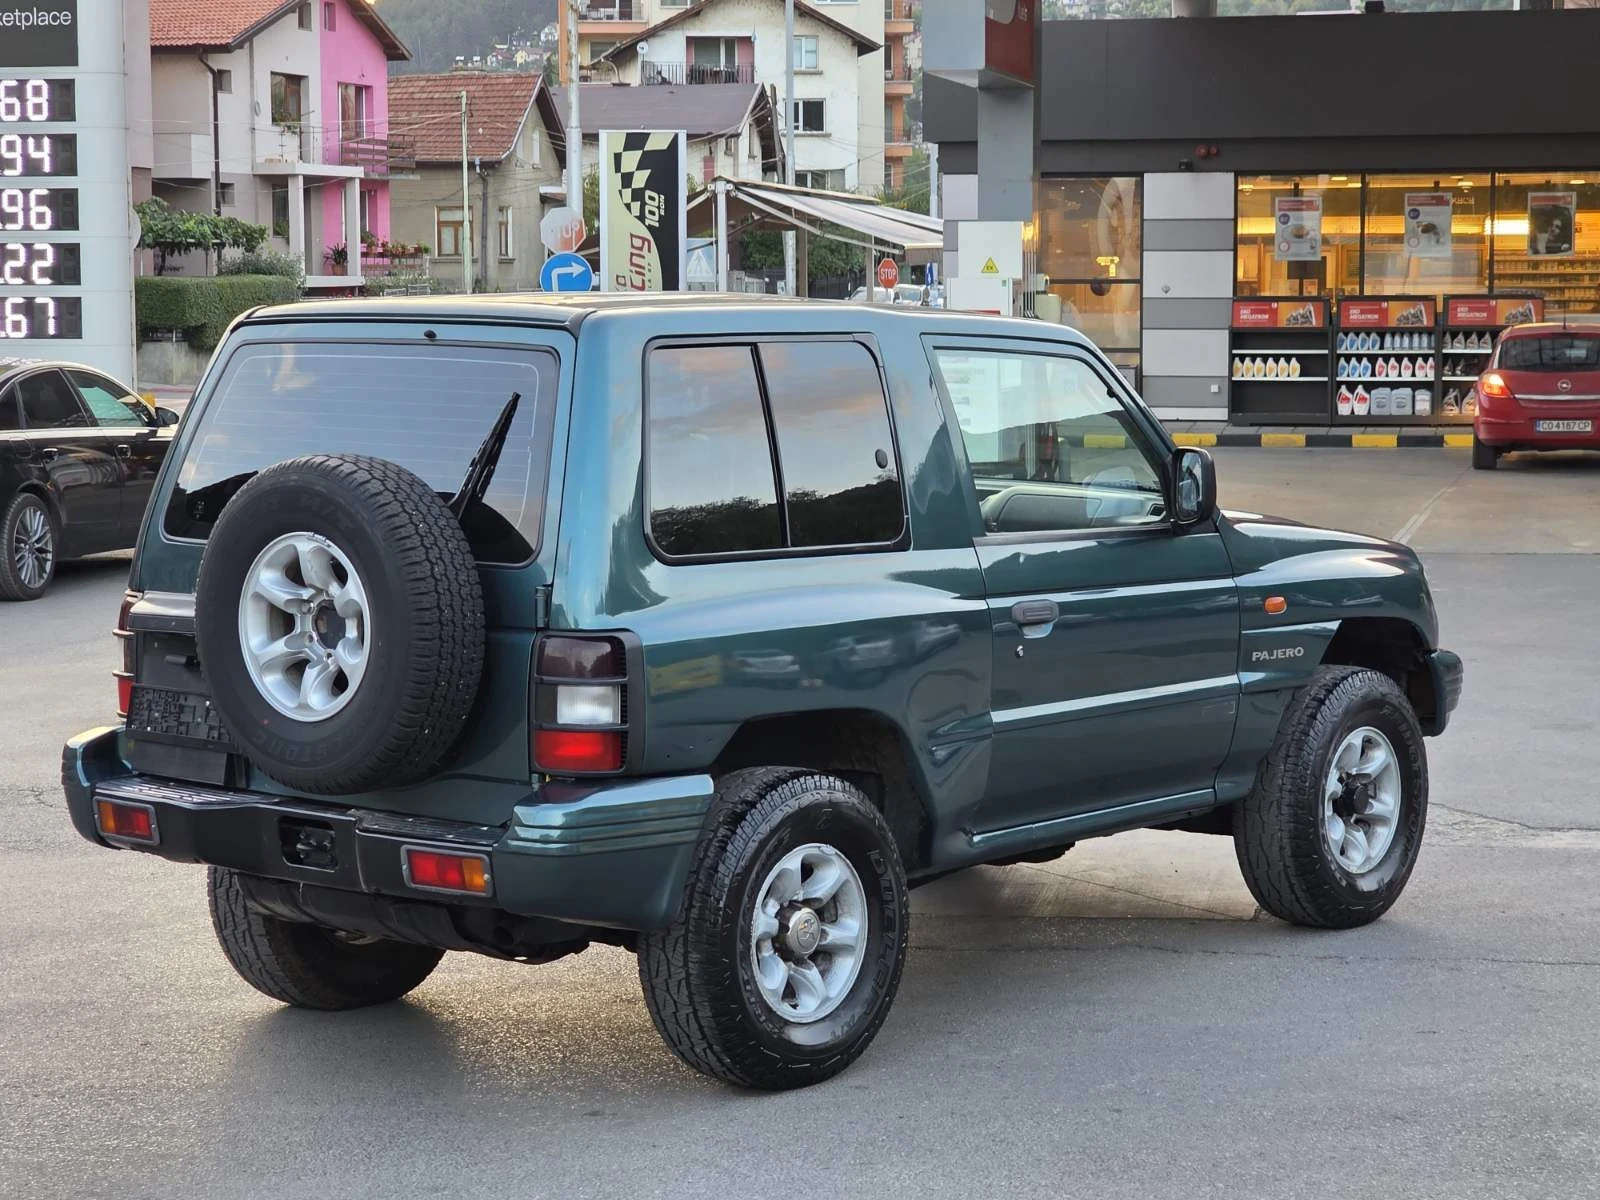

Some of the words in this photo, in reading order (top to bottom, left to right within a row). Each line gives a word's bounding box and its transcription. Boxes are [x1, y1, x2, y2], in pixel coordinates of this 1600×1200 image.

[645, 189, 660, 228] 100
[880, 270, 897, 280] STOP
[1252, 646, 1304, 662] PAJERO
